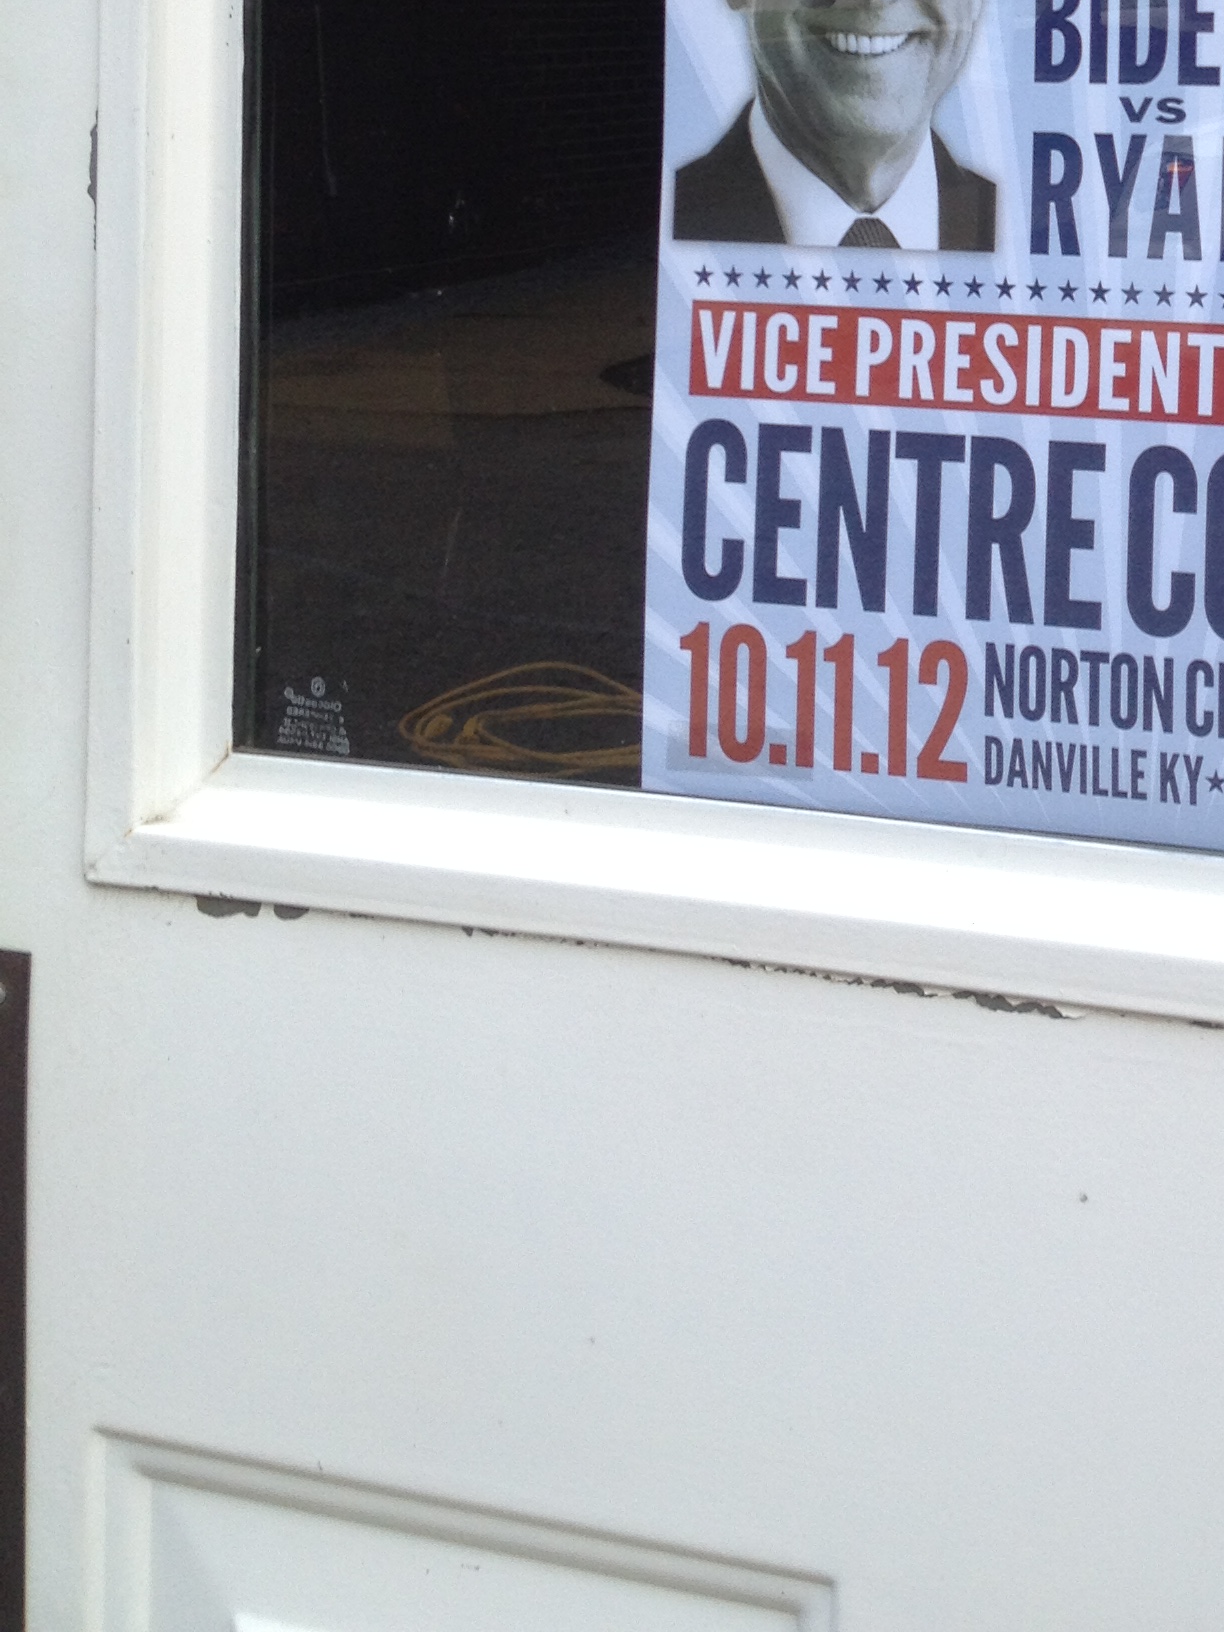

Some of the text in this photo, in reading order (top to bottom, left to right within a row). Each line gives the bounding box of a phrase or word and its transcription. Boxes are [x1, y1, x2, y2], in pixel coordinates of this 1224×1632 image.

[698, 309, 836, 396] VICE
[681, 417, 1106, 631] CENTRE
[679, 620, 969, 783] 10.11.12
[984, 641, 1174, 734] NORTON
[984, 735, 1148, 801] DANVILLE
